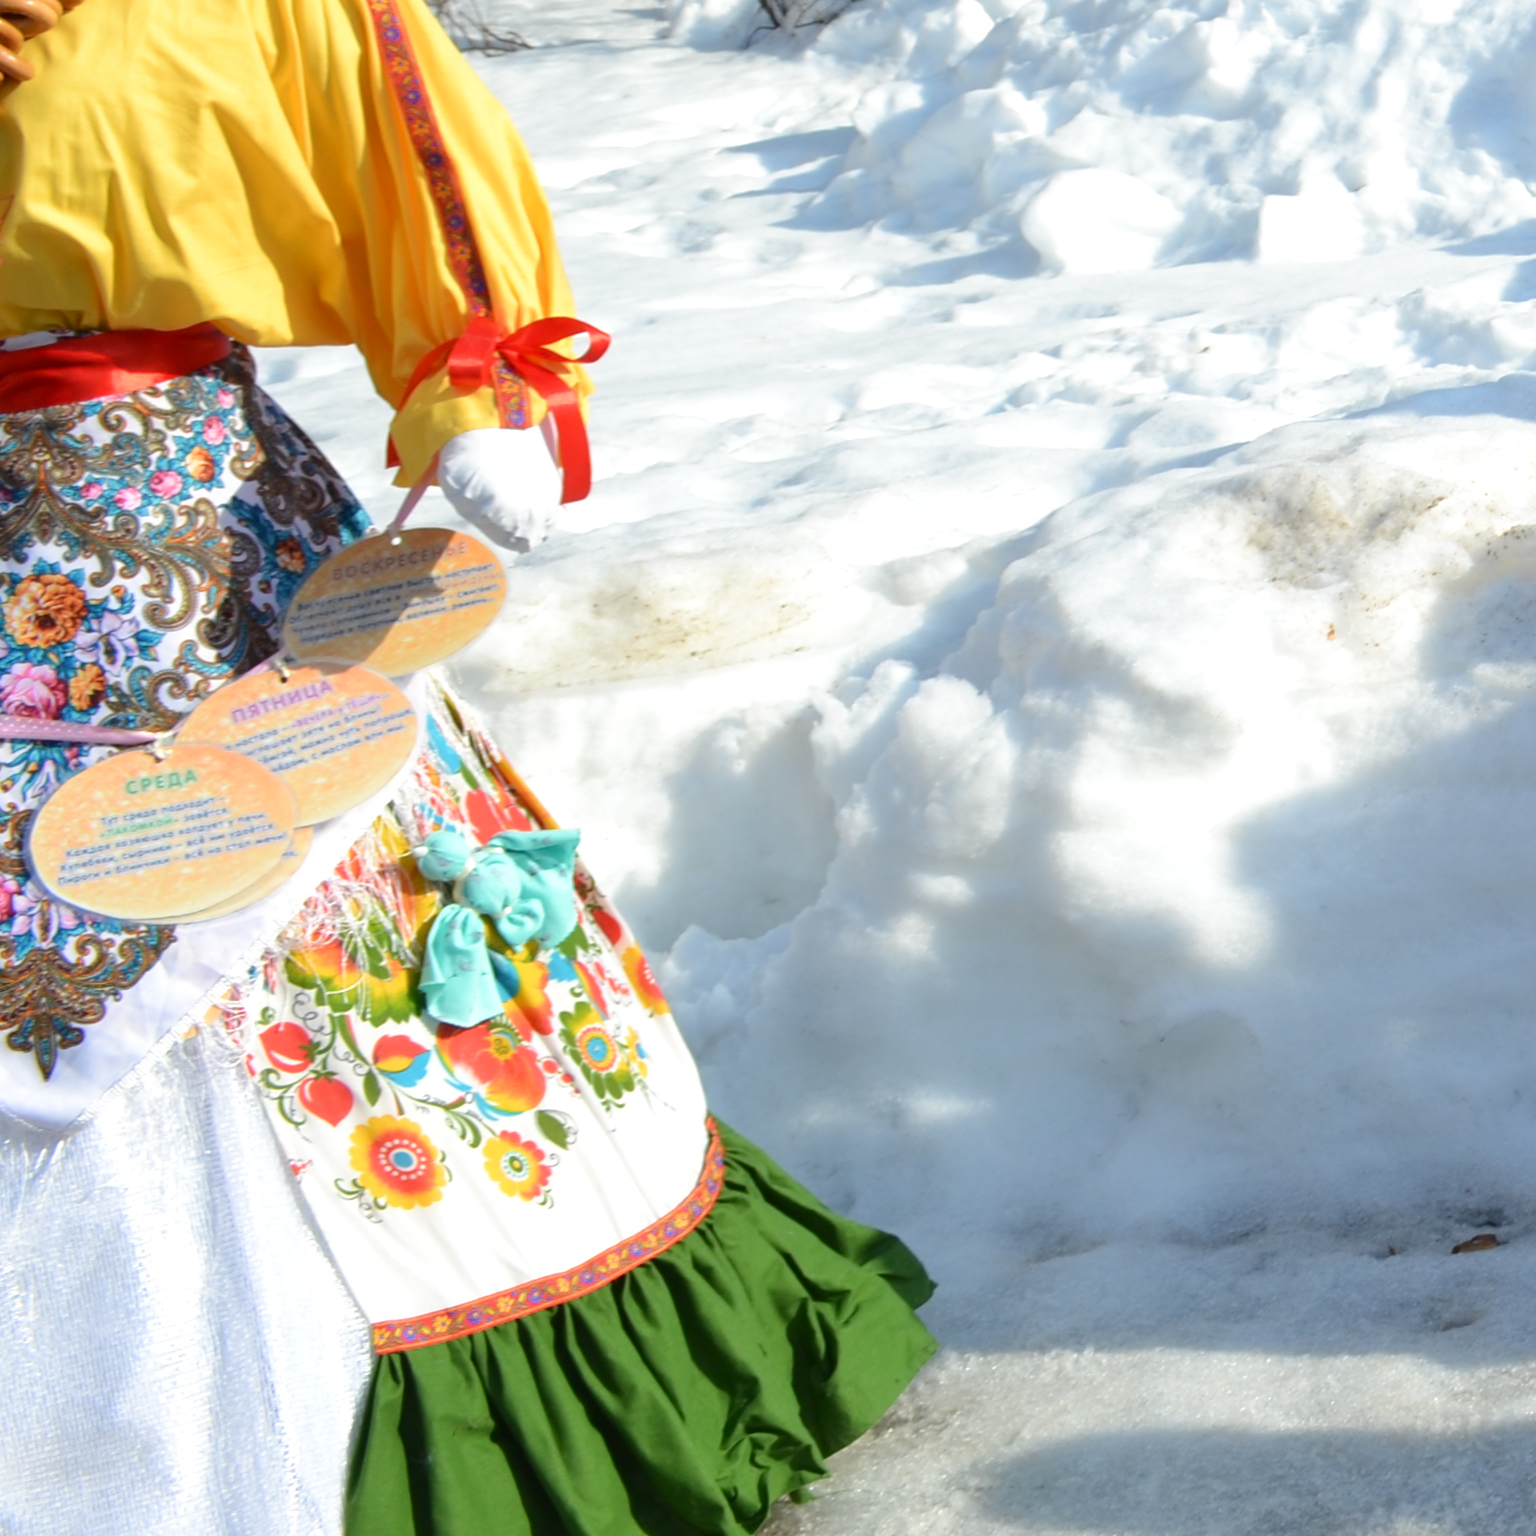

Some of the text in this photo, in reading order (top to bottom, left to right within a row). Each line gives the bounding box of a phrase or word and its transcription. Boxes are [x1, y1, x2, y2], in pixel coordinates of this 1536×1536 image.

[332, 541, 467, 581] ВОСКРЕСЕНЬЕ
[231, 679, 334, 723] ПЯТНИЦА
[125, 769, 199, 795] СРЕДА
[101, 816, 119, 827] Тут
[124, 809, 157, 822] среда
[162, 797, 214, 813] подходит
[66, 843, 110, 858] Каждая
[116, 831, 174, 848] хозяюшка
[179, 820, 223, 835] колдует
[123, 845, 172, 860] сырники
[58, 871, 100, 886] Пироги
[116, 857, 170, 874] блинчики
[226, 840, 251, 852] стол
